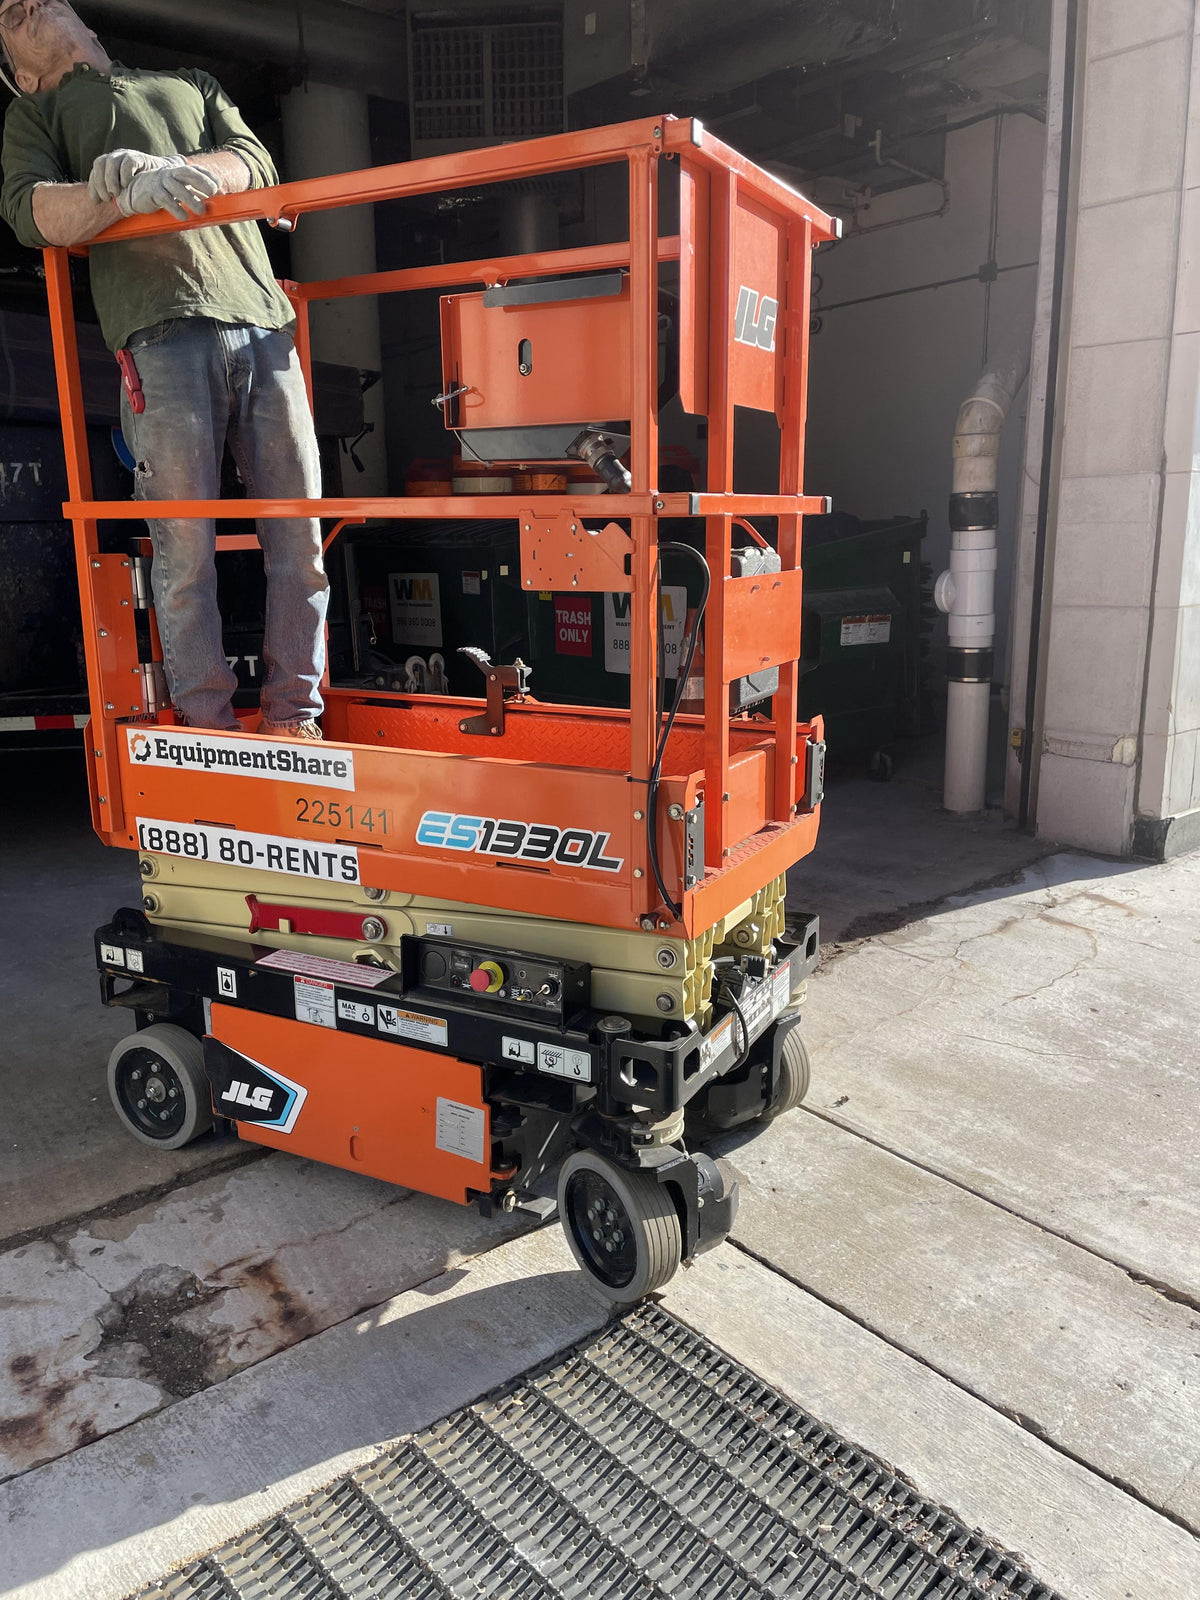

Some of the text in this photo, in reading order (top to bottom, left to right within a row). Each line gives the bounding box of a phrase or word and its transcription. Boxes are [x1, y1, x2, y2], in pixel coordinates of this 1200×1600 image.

[734, 285, 779, 351] JLG
[394, 578, 433, 600] WM
[556, 610, 591, 625] TRASH
[559, 628, 589, 643] ONLY
[613, 639, 630, 650] 888
[154, 738, 348, 778] EquipmentShare
[296, 797, 389, 835] 225141
[139, 824, 358, 882] (888) 80-RENTS
[416, 811, 624, 872] ES1330L
[341, 1002, 356, 1012] MAX
[221, 1080, 274, 1112] JLG
